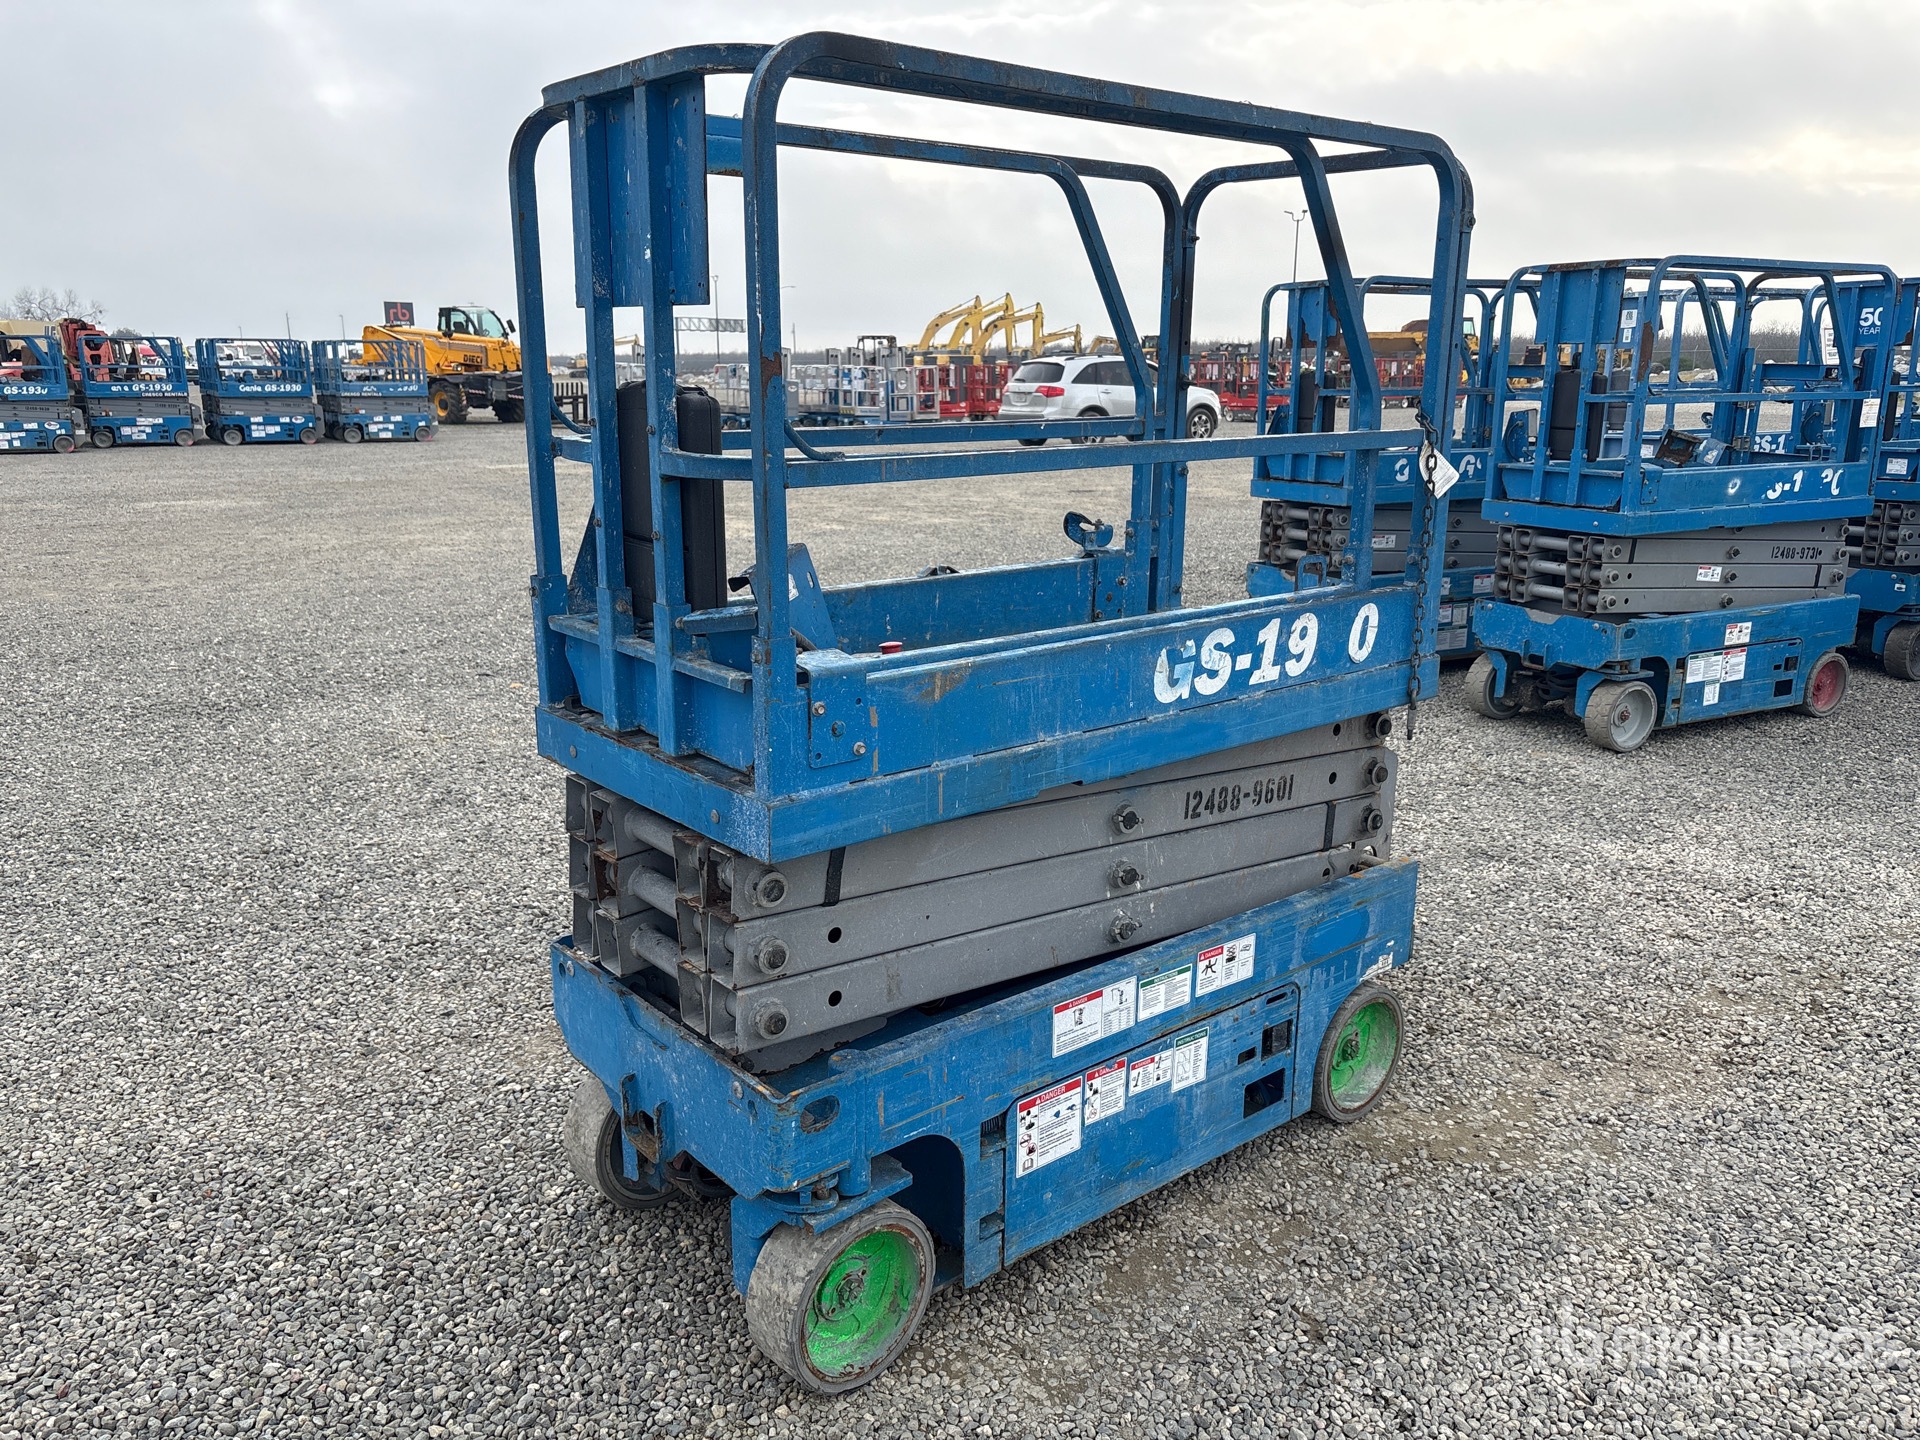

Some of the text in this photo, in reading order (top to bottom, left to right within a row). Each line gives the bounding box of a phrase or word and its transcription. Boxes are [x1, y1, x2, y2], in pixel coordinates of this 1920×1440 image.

[390, 302, 410, 321] rb
[132, 383, 173, 392] GS-1930
[265, 383, 302, 392] GS-1930
[1184, 774, 1294, 820] 12488-9601
[1205, 948, 1222, 959] DANGER
[1072, 996, 1088, 1007] DANGER
[1177, 1031, 1206, 1046] INSTRUCTIONS
[1040, 1086, 1066, 1102] DANGER
